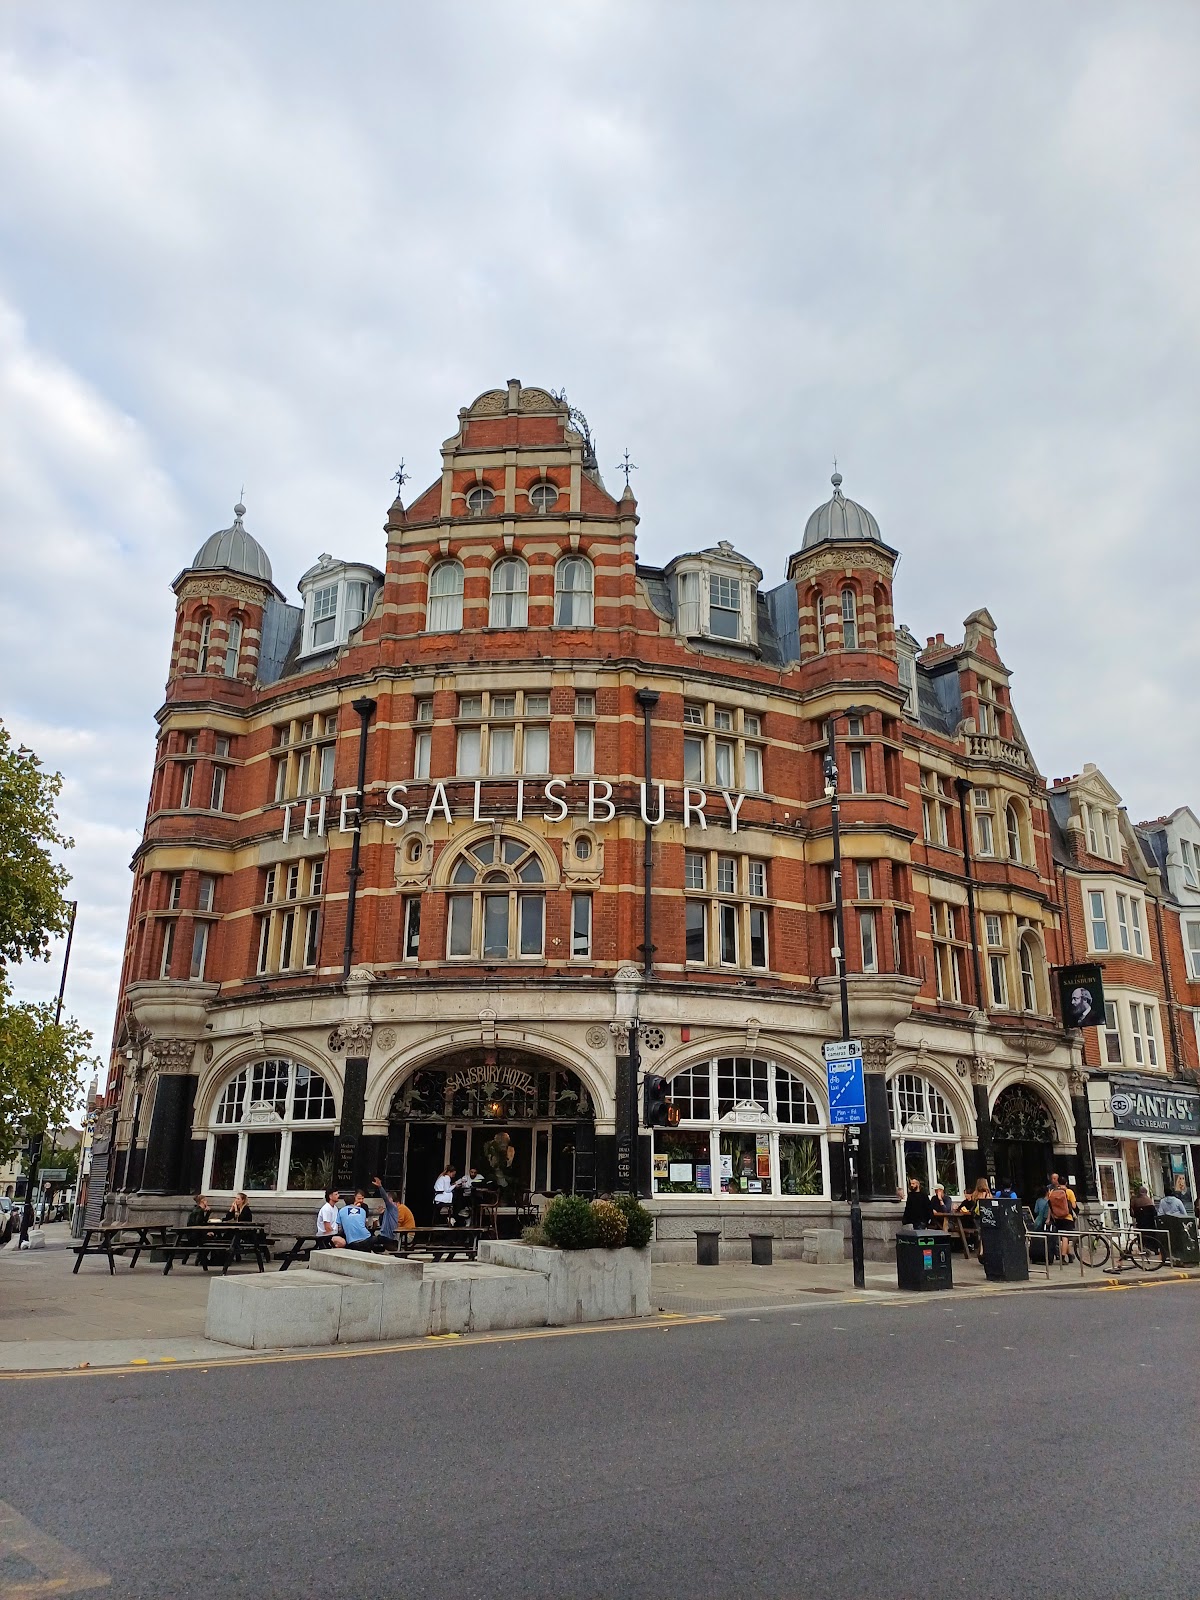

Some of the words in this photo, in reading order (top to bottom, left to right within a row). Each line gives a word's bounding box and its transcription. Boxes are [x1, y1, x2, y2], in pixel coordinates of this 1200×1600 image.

[280, 790, 361, 844] THE
[385, 779, 746, 834] SALISBURY
[1063, 977, 1097, 986] SALISBURY
[446, 1066, 503, 1092] SALISBURY
[502, 1067, 533, 1092] HOTEL
